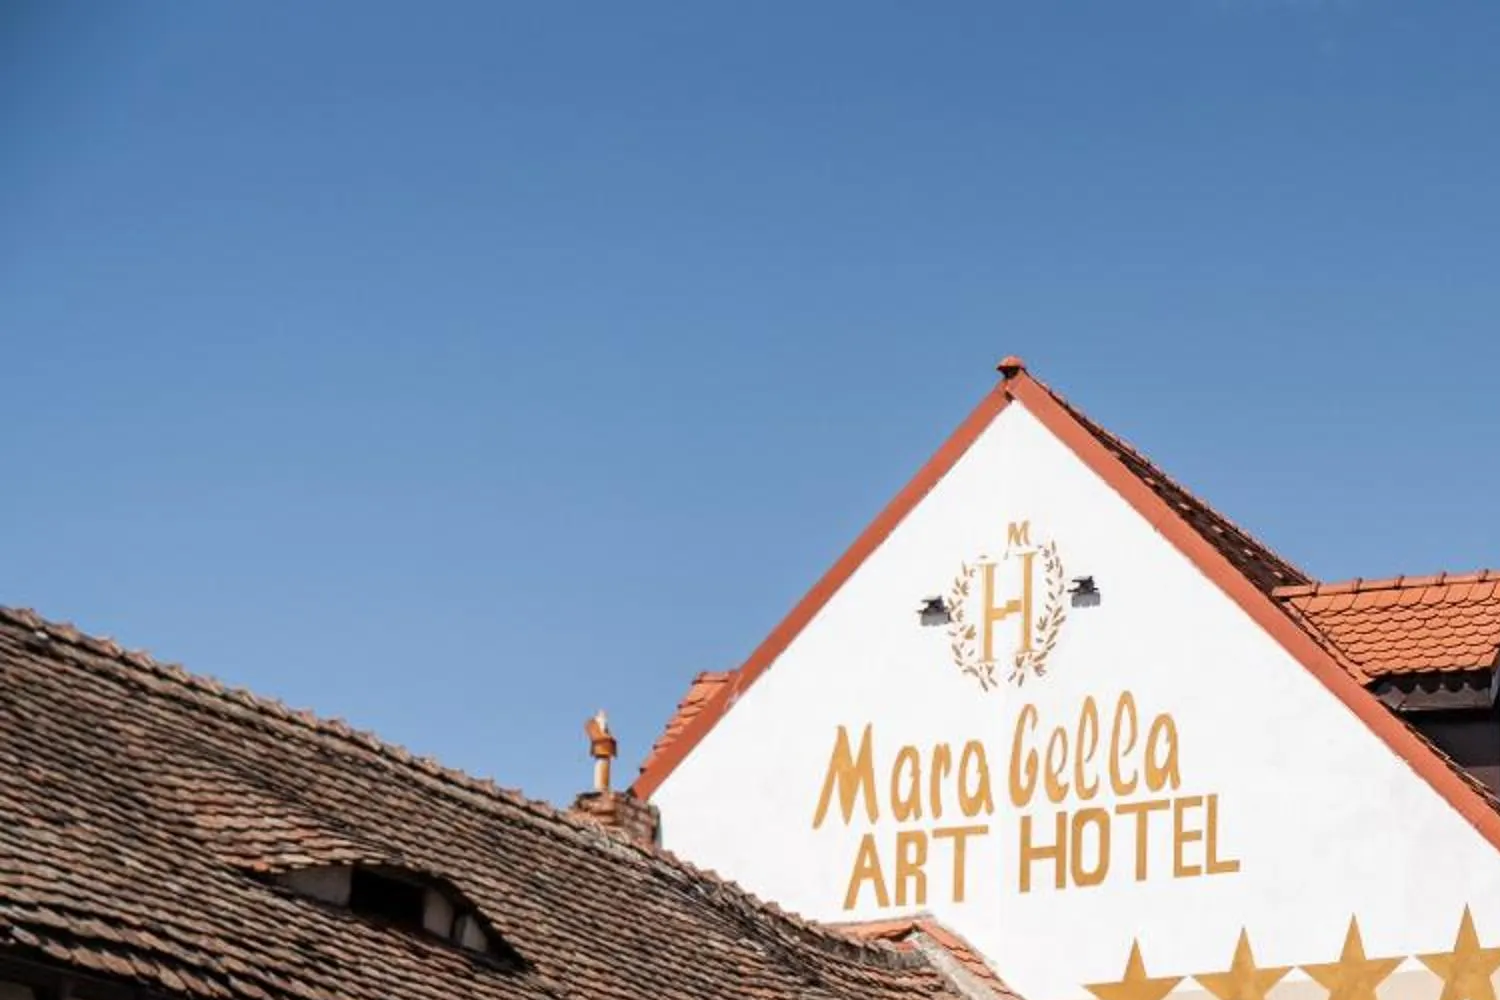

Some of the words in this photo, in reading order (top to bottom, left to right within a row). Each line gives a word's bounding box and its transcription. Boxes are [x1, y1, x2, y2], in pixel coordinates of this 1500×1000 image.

[975, 551, 1038, 664] H
[843, 824, 990, 910] ART
[1018, 793, 1241, 894] HOTEL
